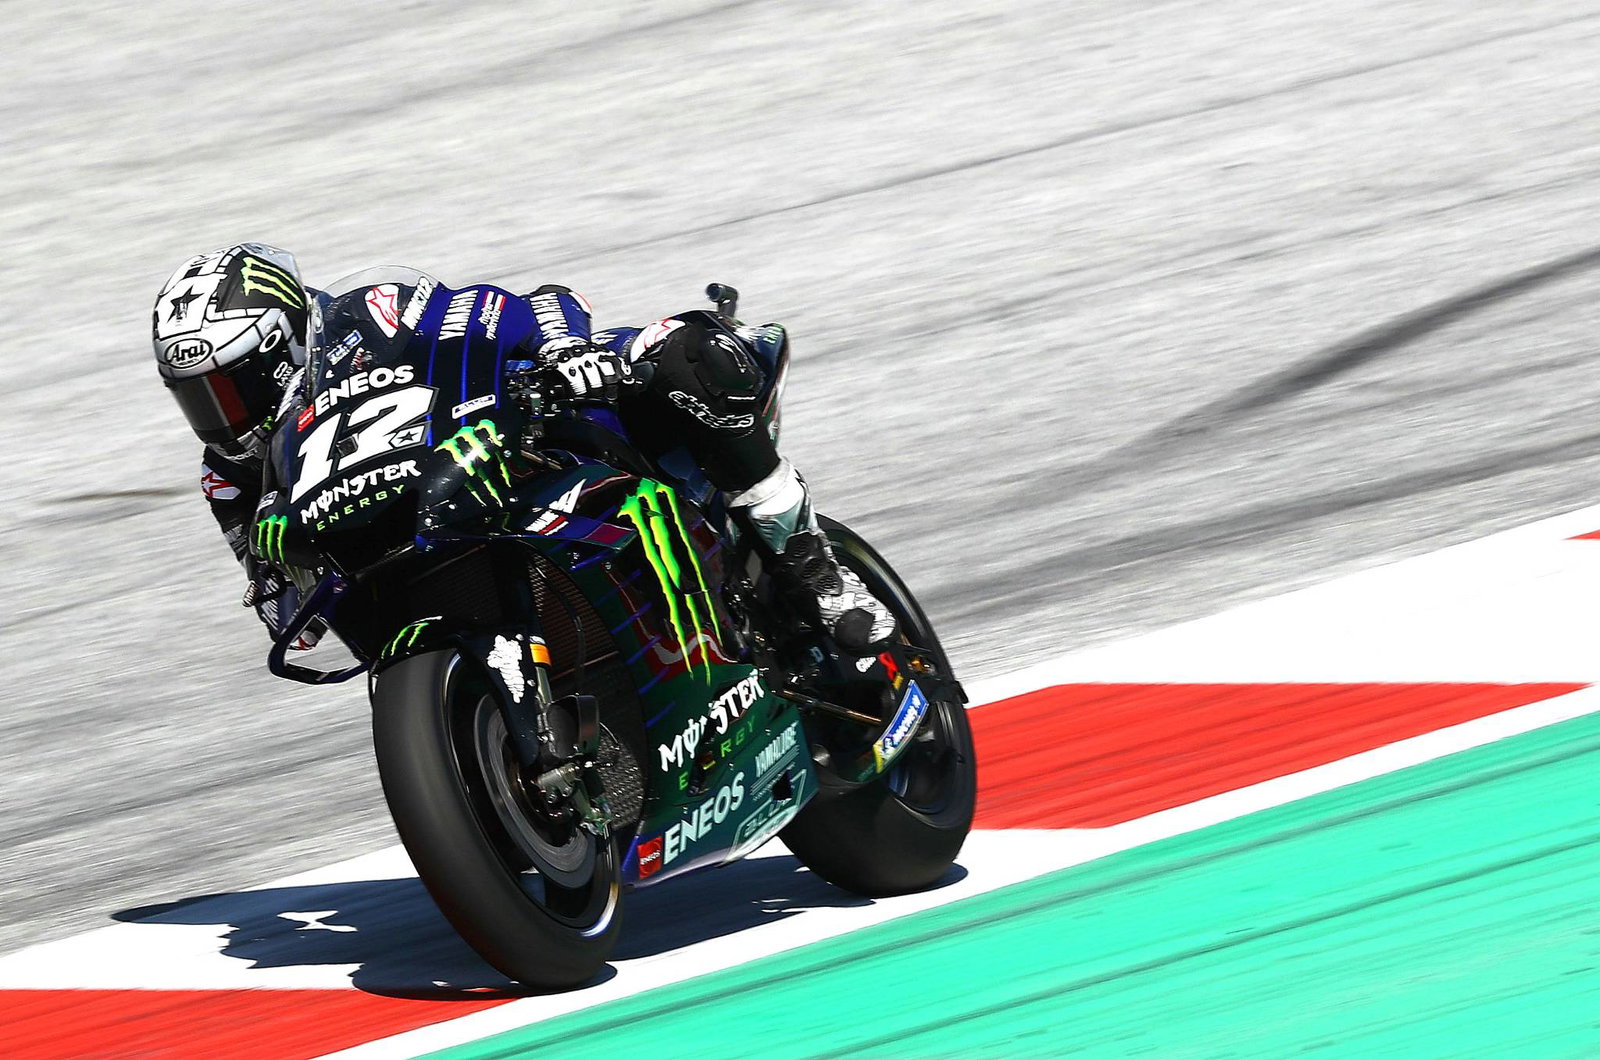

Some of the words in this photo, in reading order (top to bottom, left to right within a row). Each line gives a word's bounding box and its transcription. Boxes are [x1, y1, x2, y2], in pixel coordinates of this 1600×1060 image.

[438, 289, 479, 341] YAMAHA
[167, 339, 206, 363] Arai
[314, 365, 414, 416] ENEOS
[290, 386, 435, 504] 12
[301, 460, 422, 525] MONSTER
[317, 484, 405, 531] ENERGY
[679, 714, 756, 791] ERGY
[663, 771, 745, 865] ENEOS
